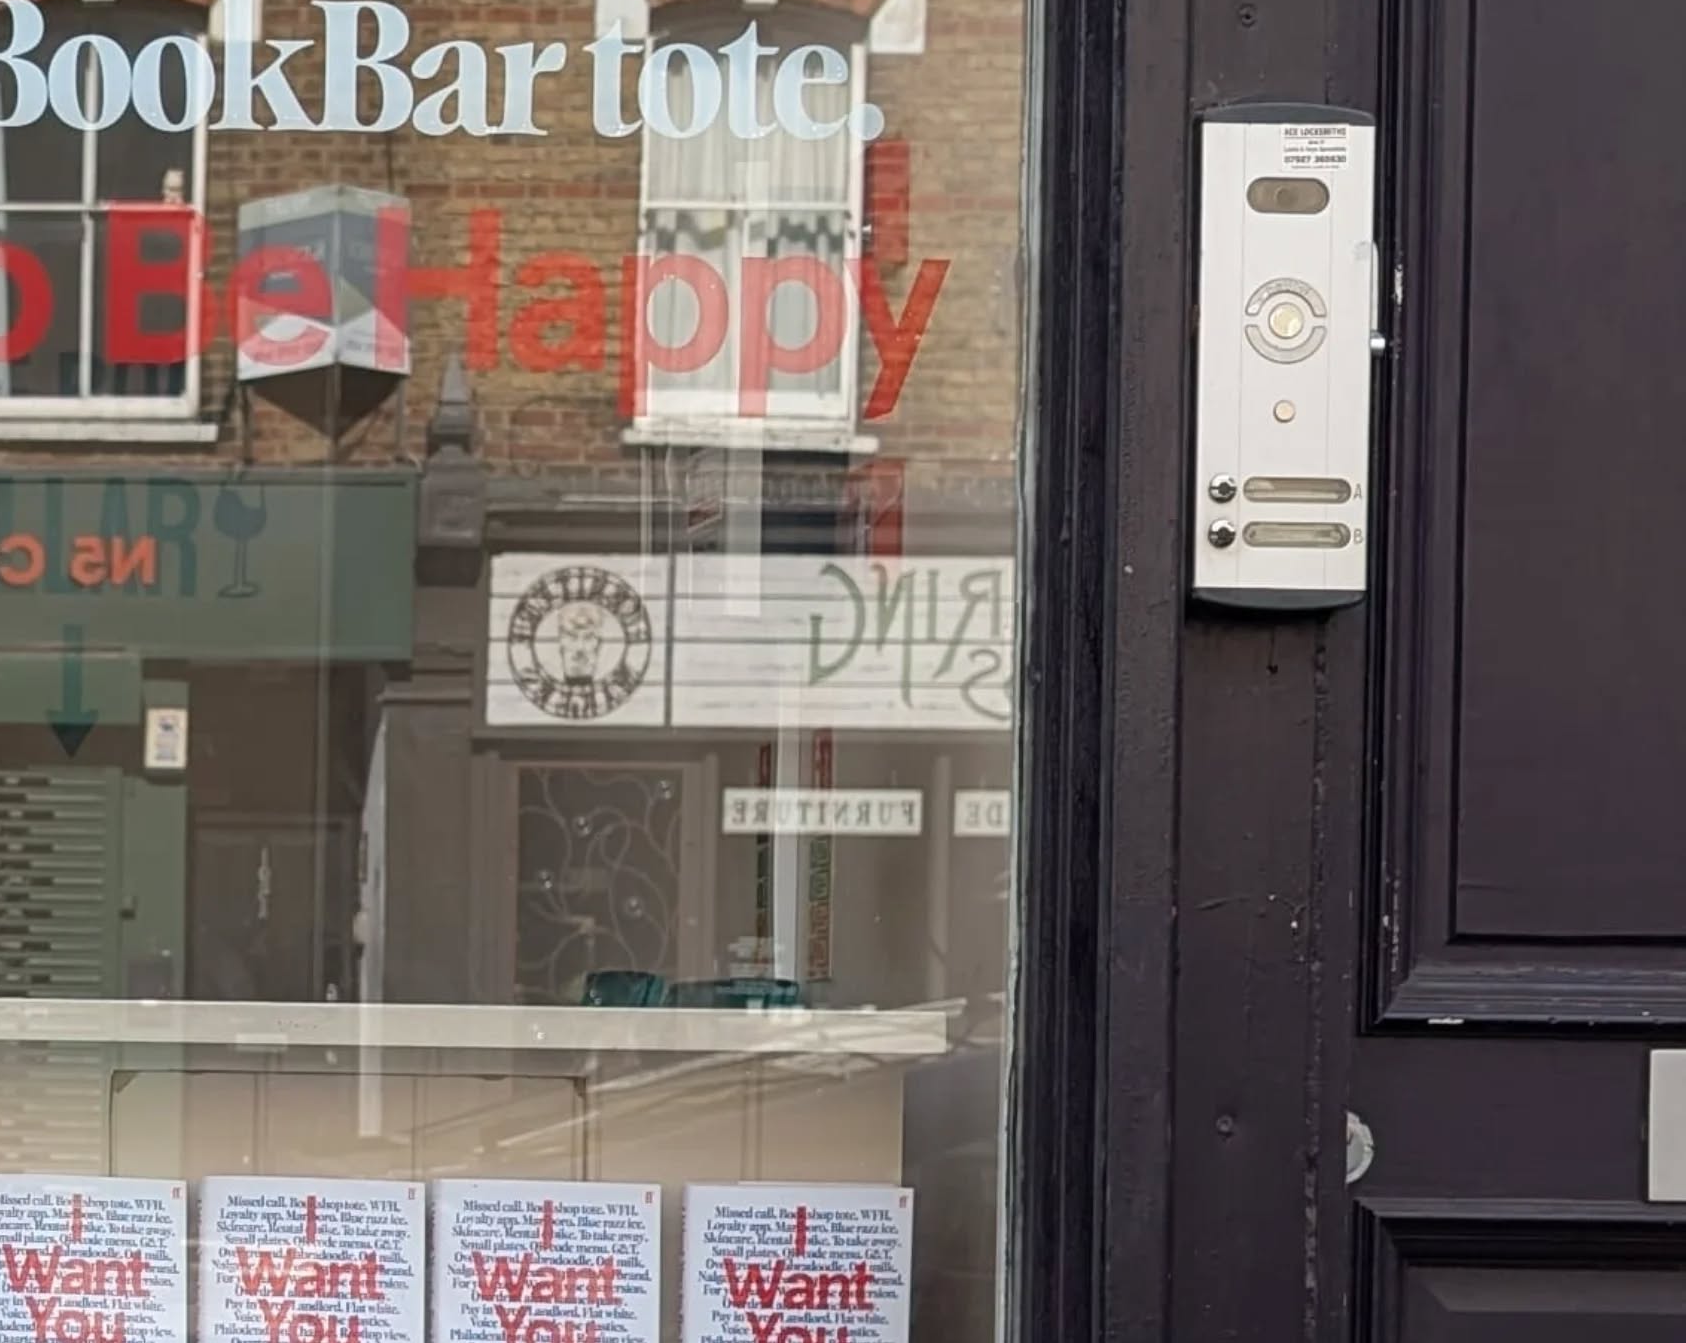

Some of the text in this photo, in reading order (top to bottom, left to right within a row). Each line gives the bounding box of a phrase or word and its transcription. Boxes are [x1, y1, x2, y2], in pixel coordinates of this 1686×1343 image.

[583, 20, 886, 142] tote.
[106, 203, 330, 371] Be
[376, 206, 950, 420] Happy
[1353, 528, 1363, 545] B
[71, 1194, 83, 1241] I
[542, 1199, 554, 1249] I
[795, 1206, 806, 1257] I
[3, 1244, 152, 1297] Want
[472, 1252, 622, 1305] Want
[723, 1257, 875, 1311] Want
